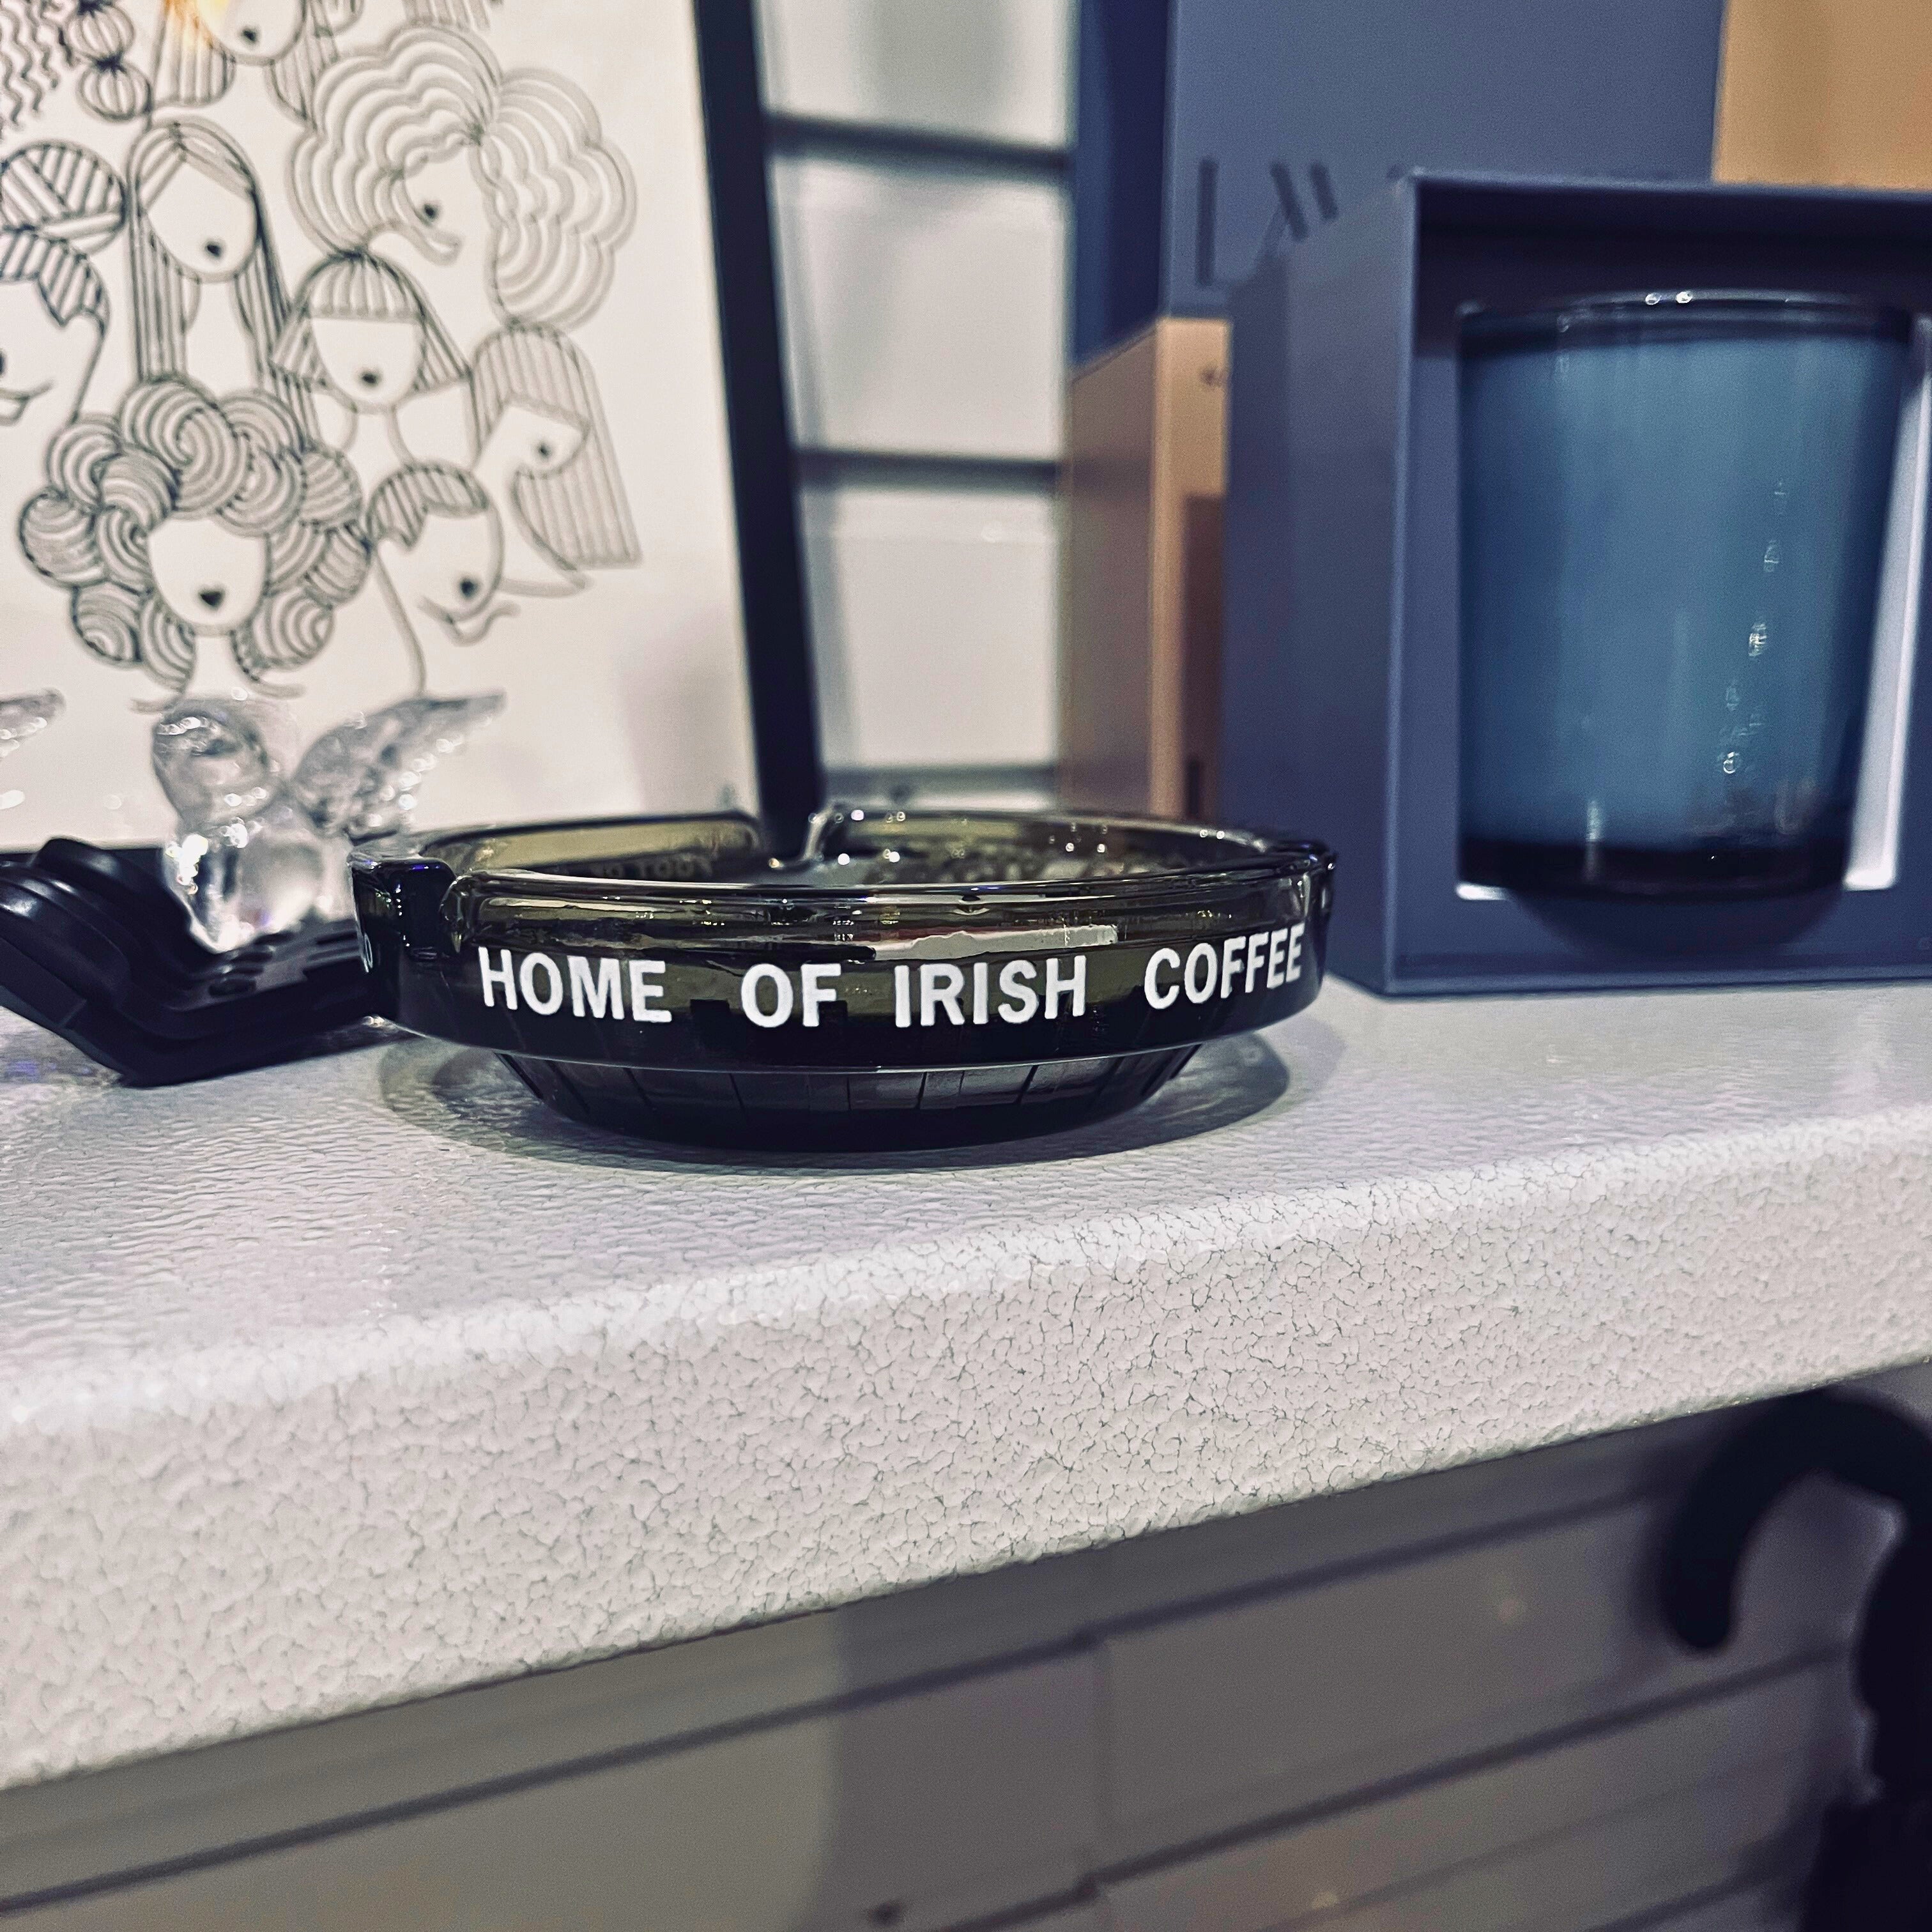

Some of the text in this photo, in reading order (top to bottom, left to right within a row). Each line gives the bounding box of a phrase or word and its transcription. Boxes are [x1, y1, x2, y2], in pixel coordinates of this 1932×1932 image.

[478, 923, 1305, 1028] HOME OF IRISH COFFEE
